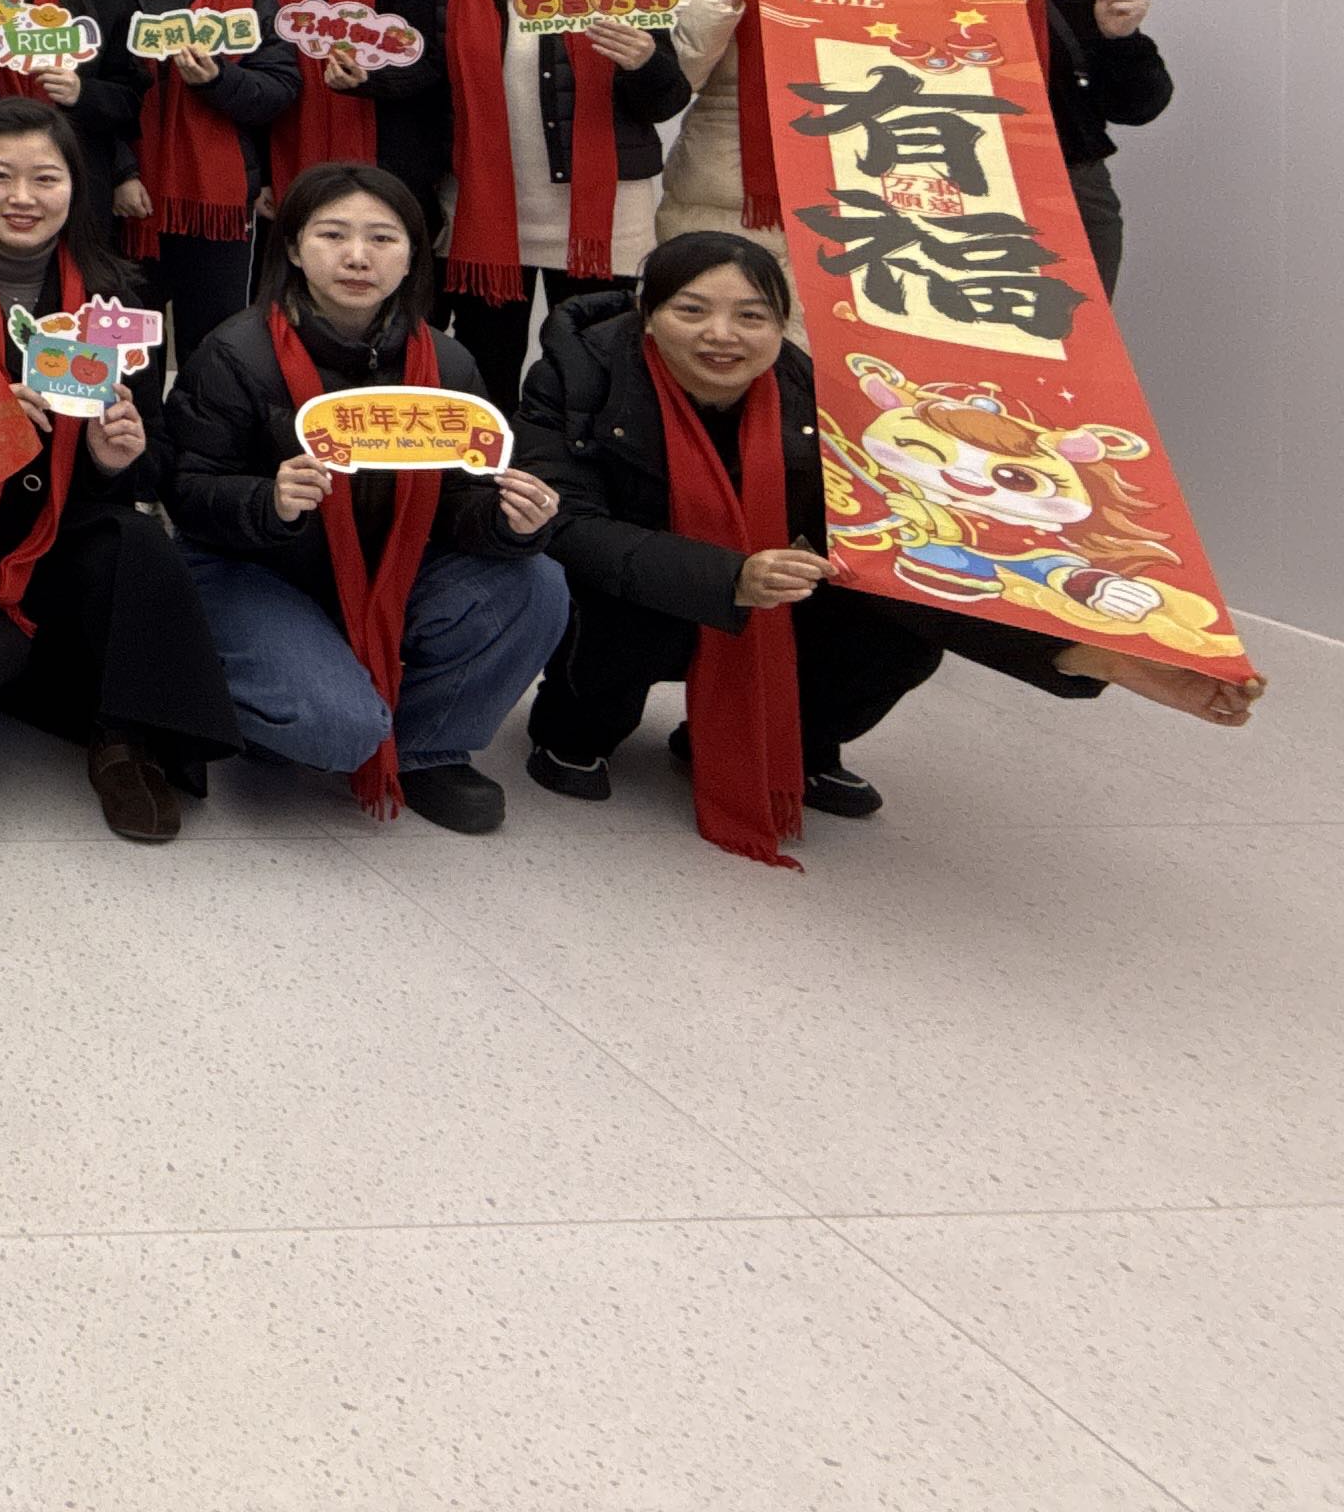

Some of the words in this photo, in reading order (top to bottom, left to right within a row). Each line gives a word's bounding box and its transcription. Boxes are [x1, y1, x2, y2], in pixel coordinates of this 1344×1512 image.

[518, 19, 577, 33] HAPPY
[626, 14, 674, 27] YEAR
[17, 31, 71, 53] RICH
[787, 65, 1092, 340] 有福
[49, 381, 95, 397] LUCKY
[335, 402, 468, 433] 新年大吉
[351, 437, 390, 449] Happy
[397, 437, 424, 448] New
[430, 437, 460, 448] Year
